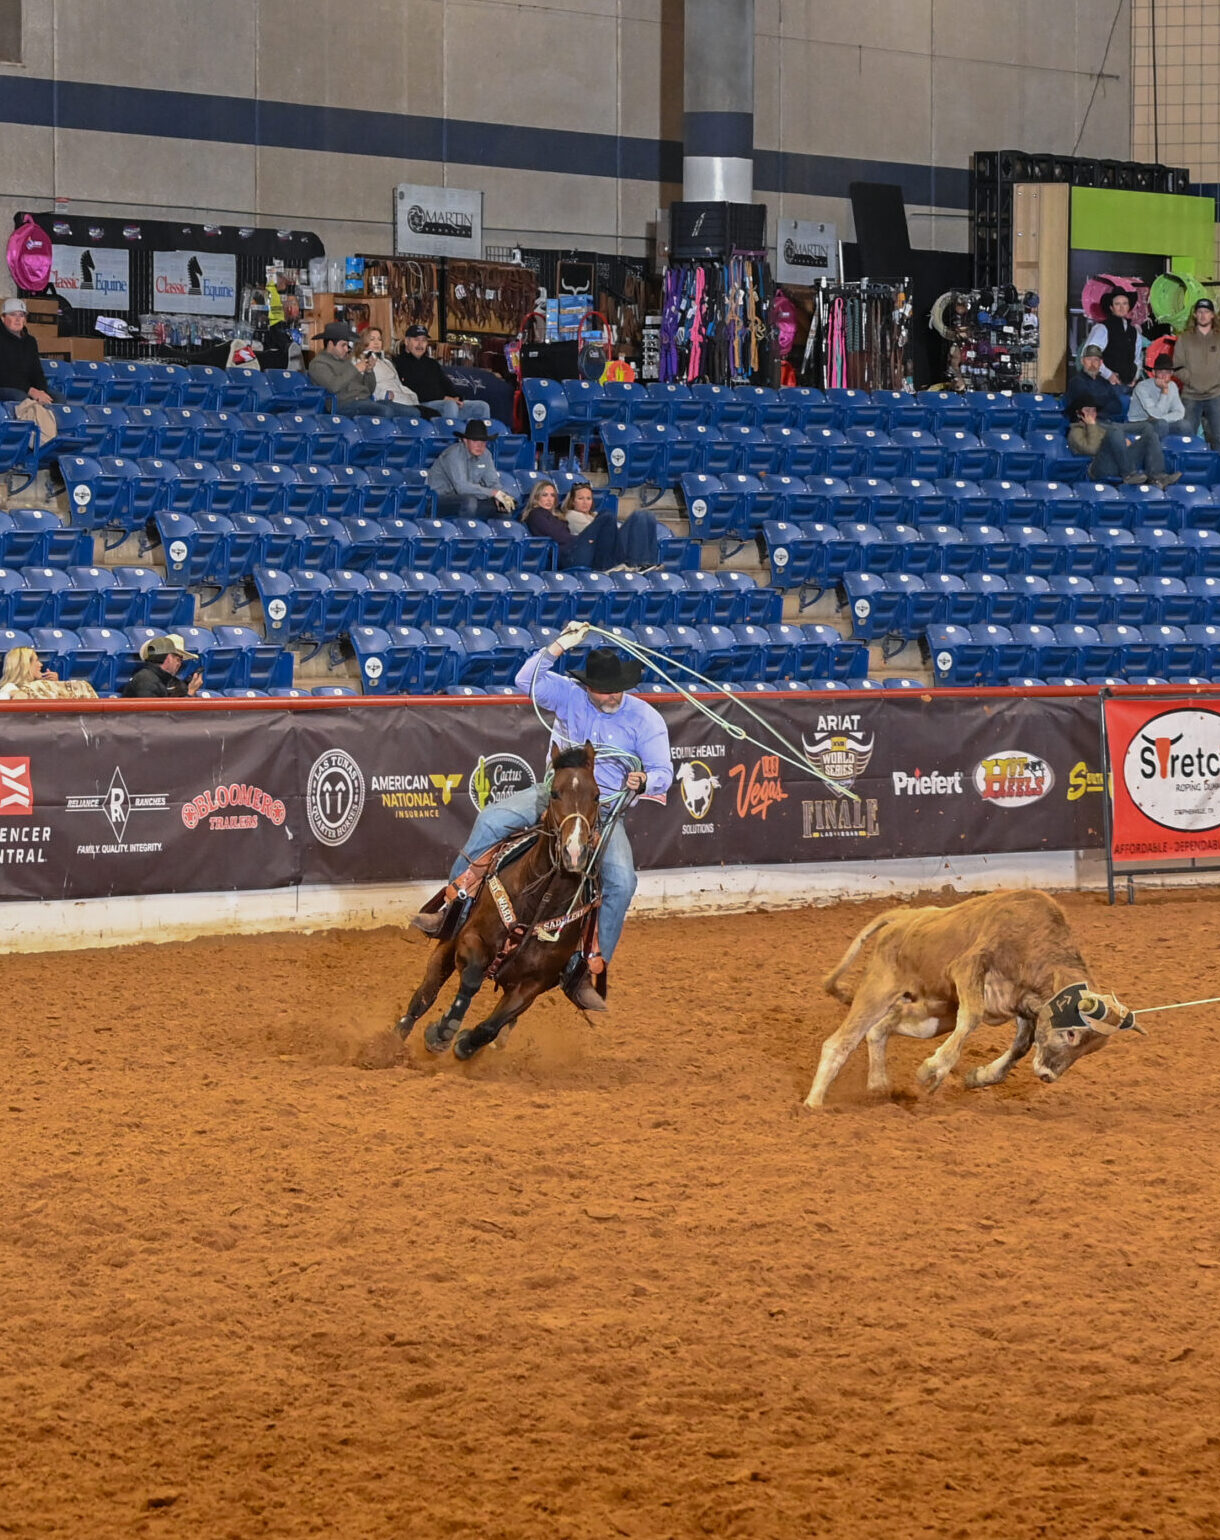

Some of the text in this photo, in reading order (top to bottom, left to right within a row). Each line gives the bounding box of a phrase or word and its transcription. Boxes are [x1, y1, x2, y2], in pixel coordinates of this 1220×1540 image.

[425, 209, 473, 228] MARTIN
[95, 272, 128, 296] Equine
[156, 275, 234, 301] Classic Equine
[817, 715, 861, 731] ARIAT
[671, 744, 726, 759] EQUINE HEALTH
[823, 751, 855, 765] WORLD
[314, 756, 358, 782] LAS TUNAS
[493, 764, 522, 786] Cactus
[824, 764, 854, 777] SERIES
[371, 774, 429, 791] AMERICAN
[729, 760, 789, 820] Vegas
[892, 770, 963, 796] Priefert
[1175, 783, 1201, 793] ROPING
[67, 797, 166, 808] RELIANCE RANCHES
[193, 783, 273, 819] BLOOMER
[382, 793, 438, 808] NATIONAL
[395, 809, 440, 818] INSURANCE
[802, 799, 880, 838] FINALE
[209, 815, 259, 831] TRAILERS
[682, 823, 715, 835] SOLUTIONS
[1113, 841, 1168, 854] AFFORDABLE
